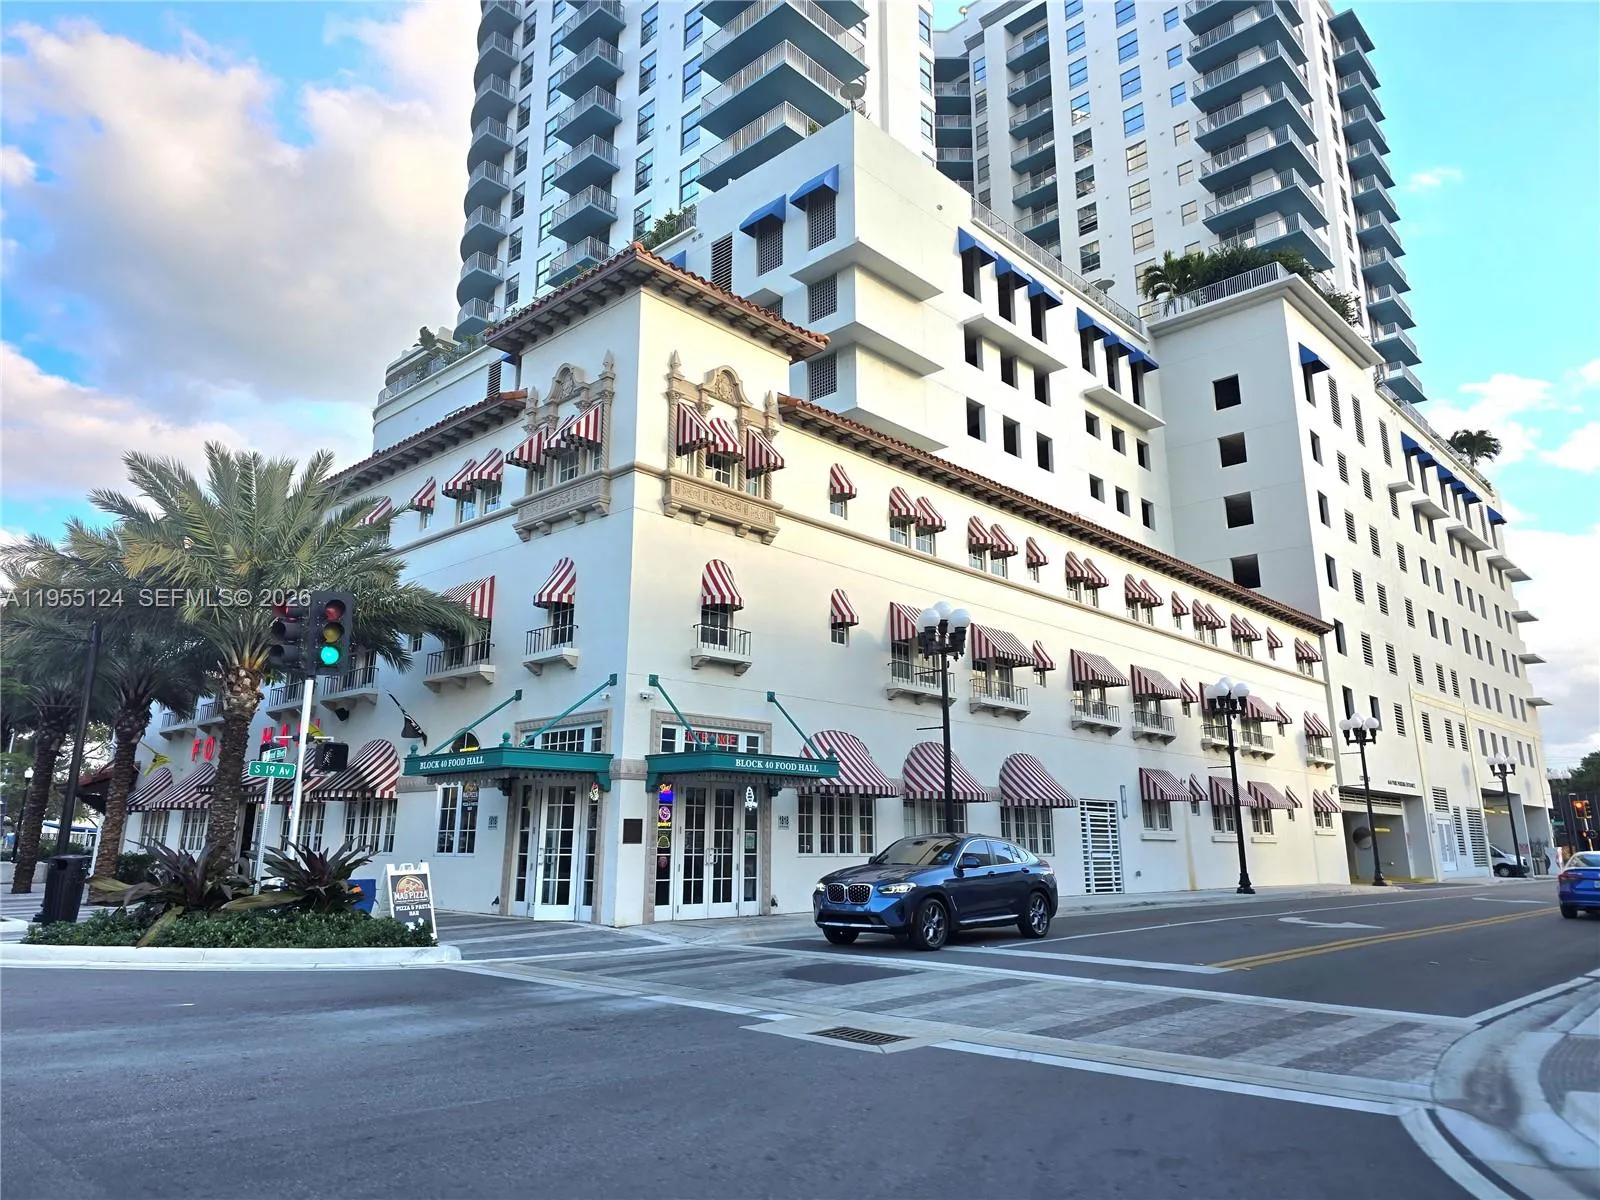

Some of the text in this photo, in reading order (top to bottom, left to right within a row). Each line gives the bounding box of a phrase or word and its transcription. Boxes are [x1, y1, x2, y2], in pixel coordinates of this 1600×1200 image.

[419, 756, 485, 770] BLOCK 40 FOOD HALL
[735, 758, 819, 772] BLOCK 40 FOOD HALL
[254, 764, 290, 775] S 19 Av
[409, 890, 428, 899] PIZZA
